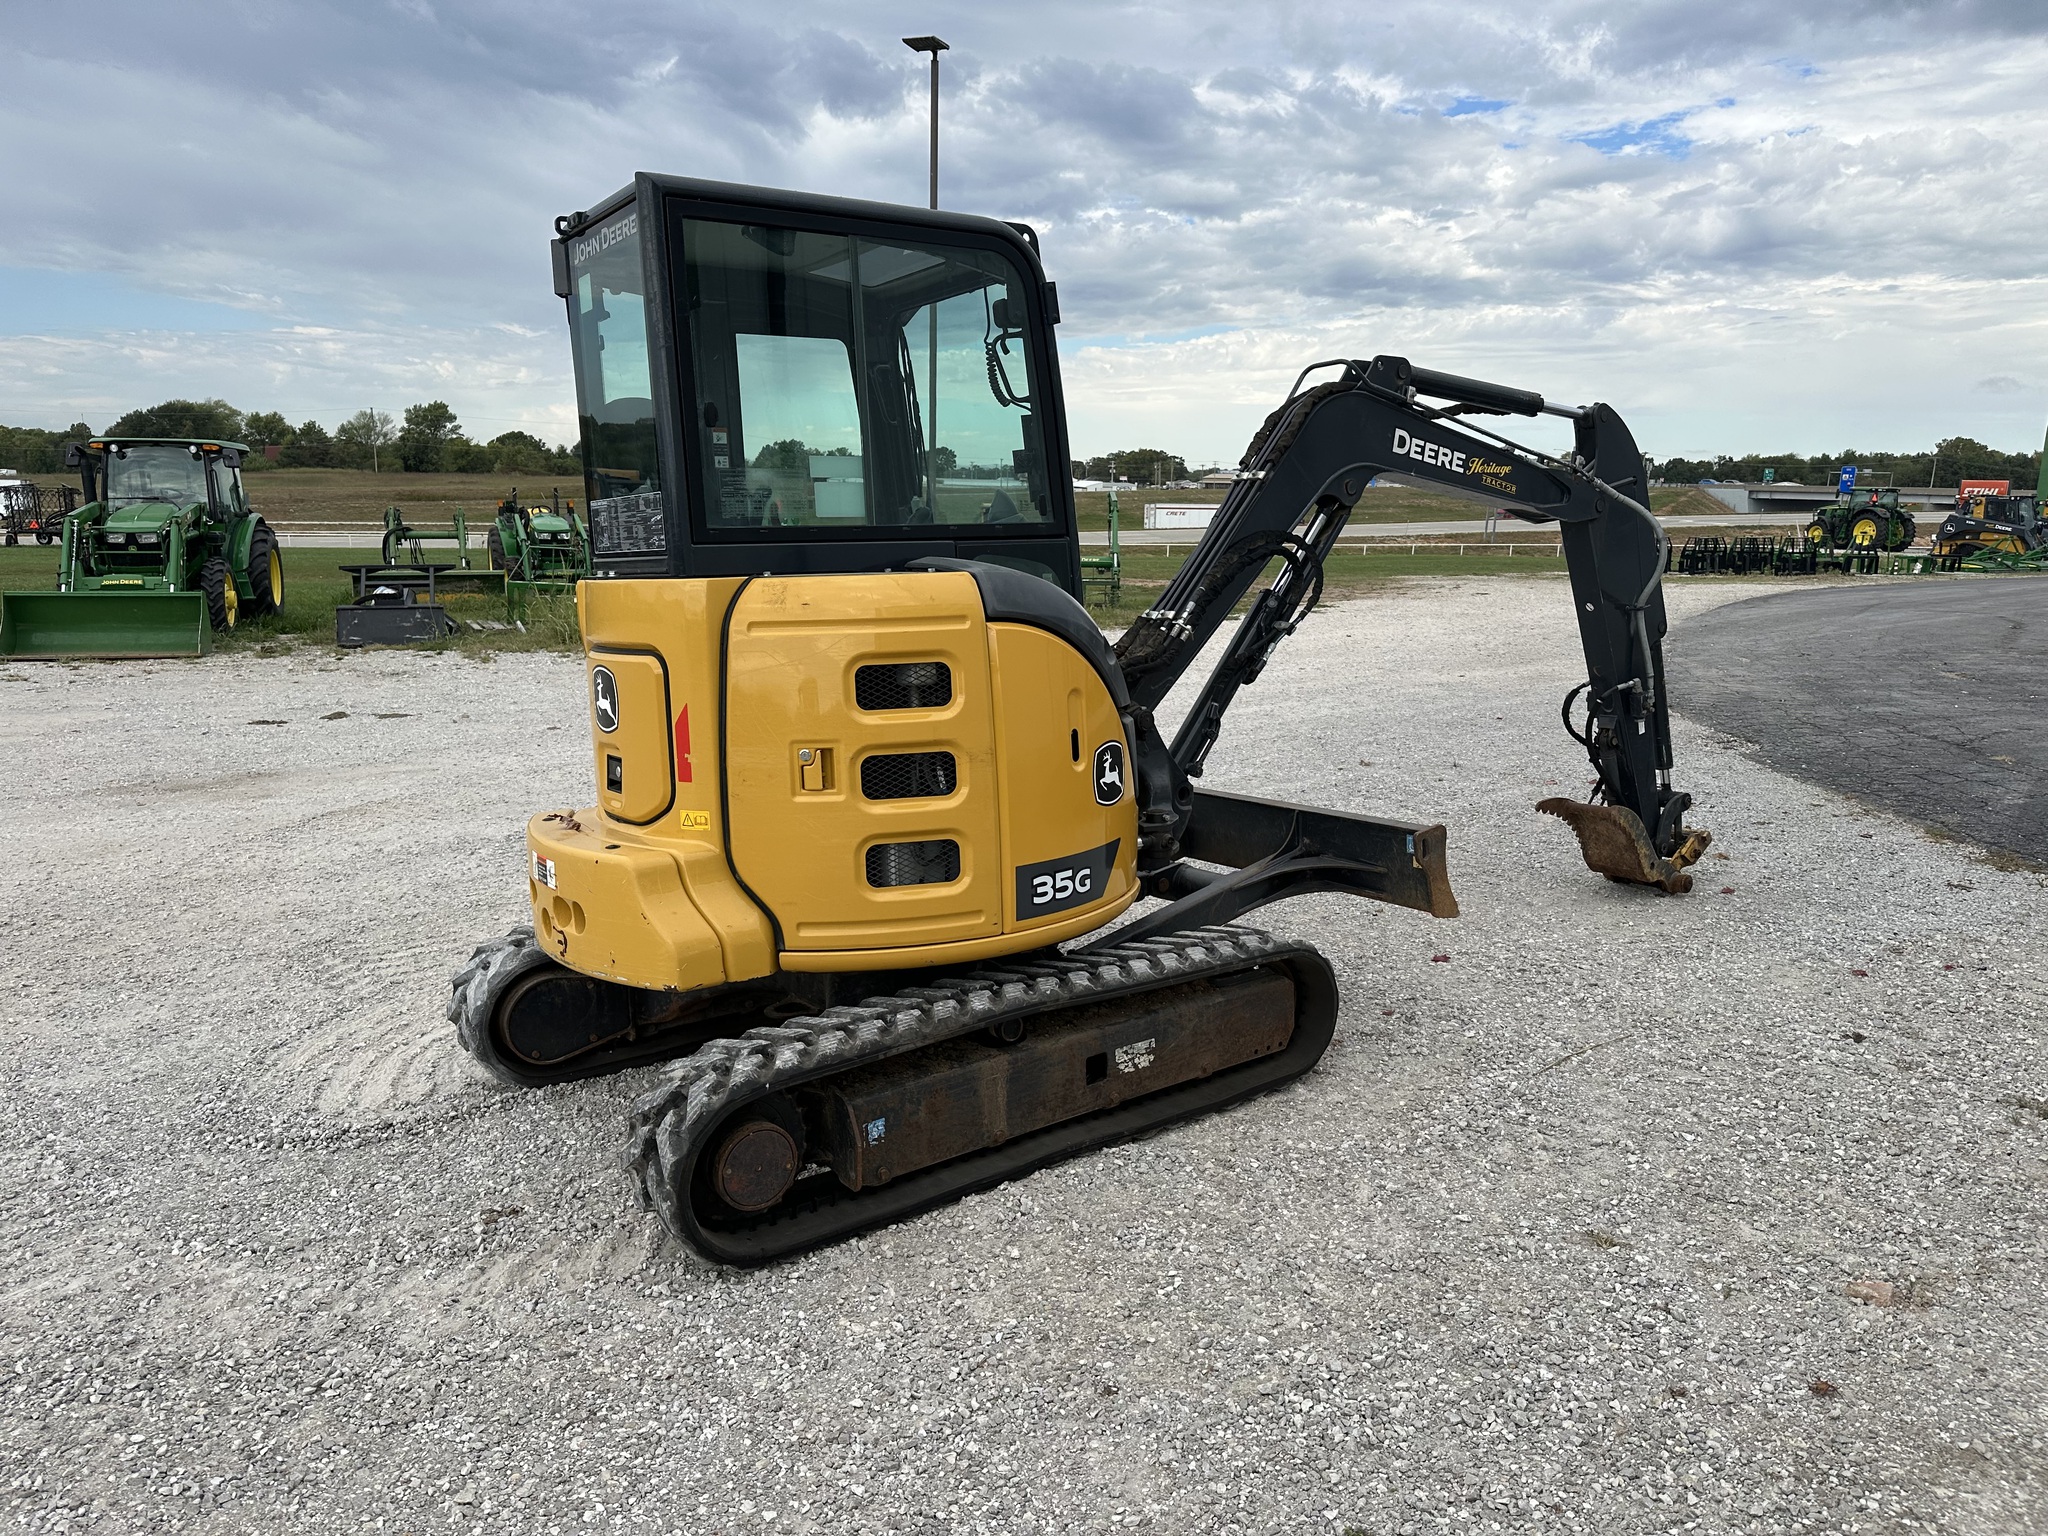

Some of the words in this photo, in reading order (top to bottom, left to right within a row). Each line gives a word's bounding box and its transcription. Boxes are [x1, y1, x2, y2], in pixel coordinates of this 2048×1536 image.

[574, 235, 600, 265] JOHN
[600, 213, 637, 250] DEERE
[1392, 428, 1466, 473] DEERE
[1466, 457, 1512, 477] Heritage
[1482, 476, 1516, 493] TRACTOR
[1962, 487, 1999, 497] STIHL
[1033, 868, 1091, 904] 35G
